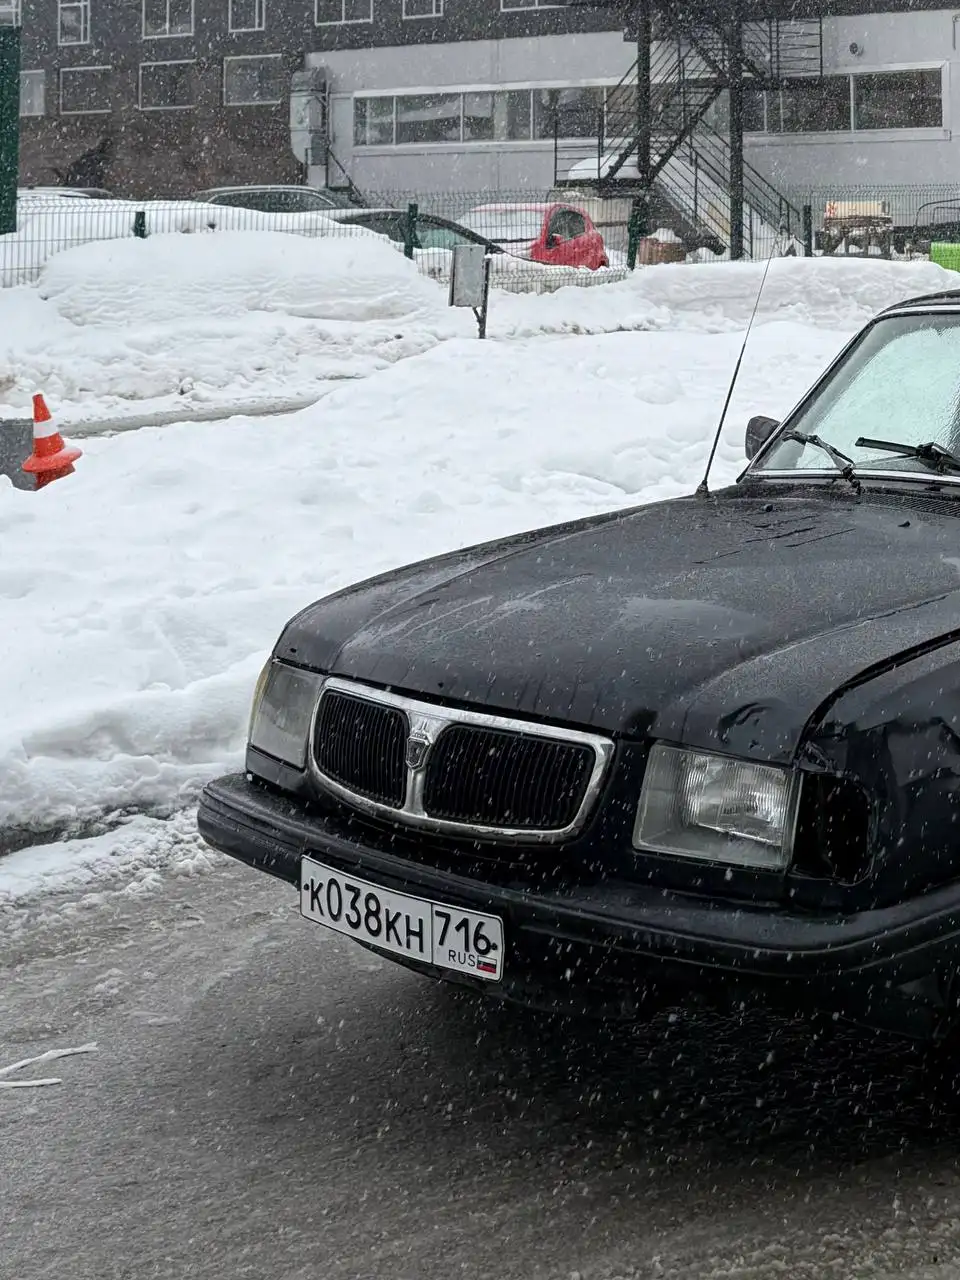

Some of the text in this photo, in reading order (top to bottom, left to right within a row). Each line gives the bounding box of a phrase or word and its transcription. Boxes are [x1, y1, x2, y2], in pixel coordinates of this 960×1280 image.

[310, 877, 492, 956] К038КН 716
[448, 949, 476, 968] RUS
